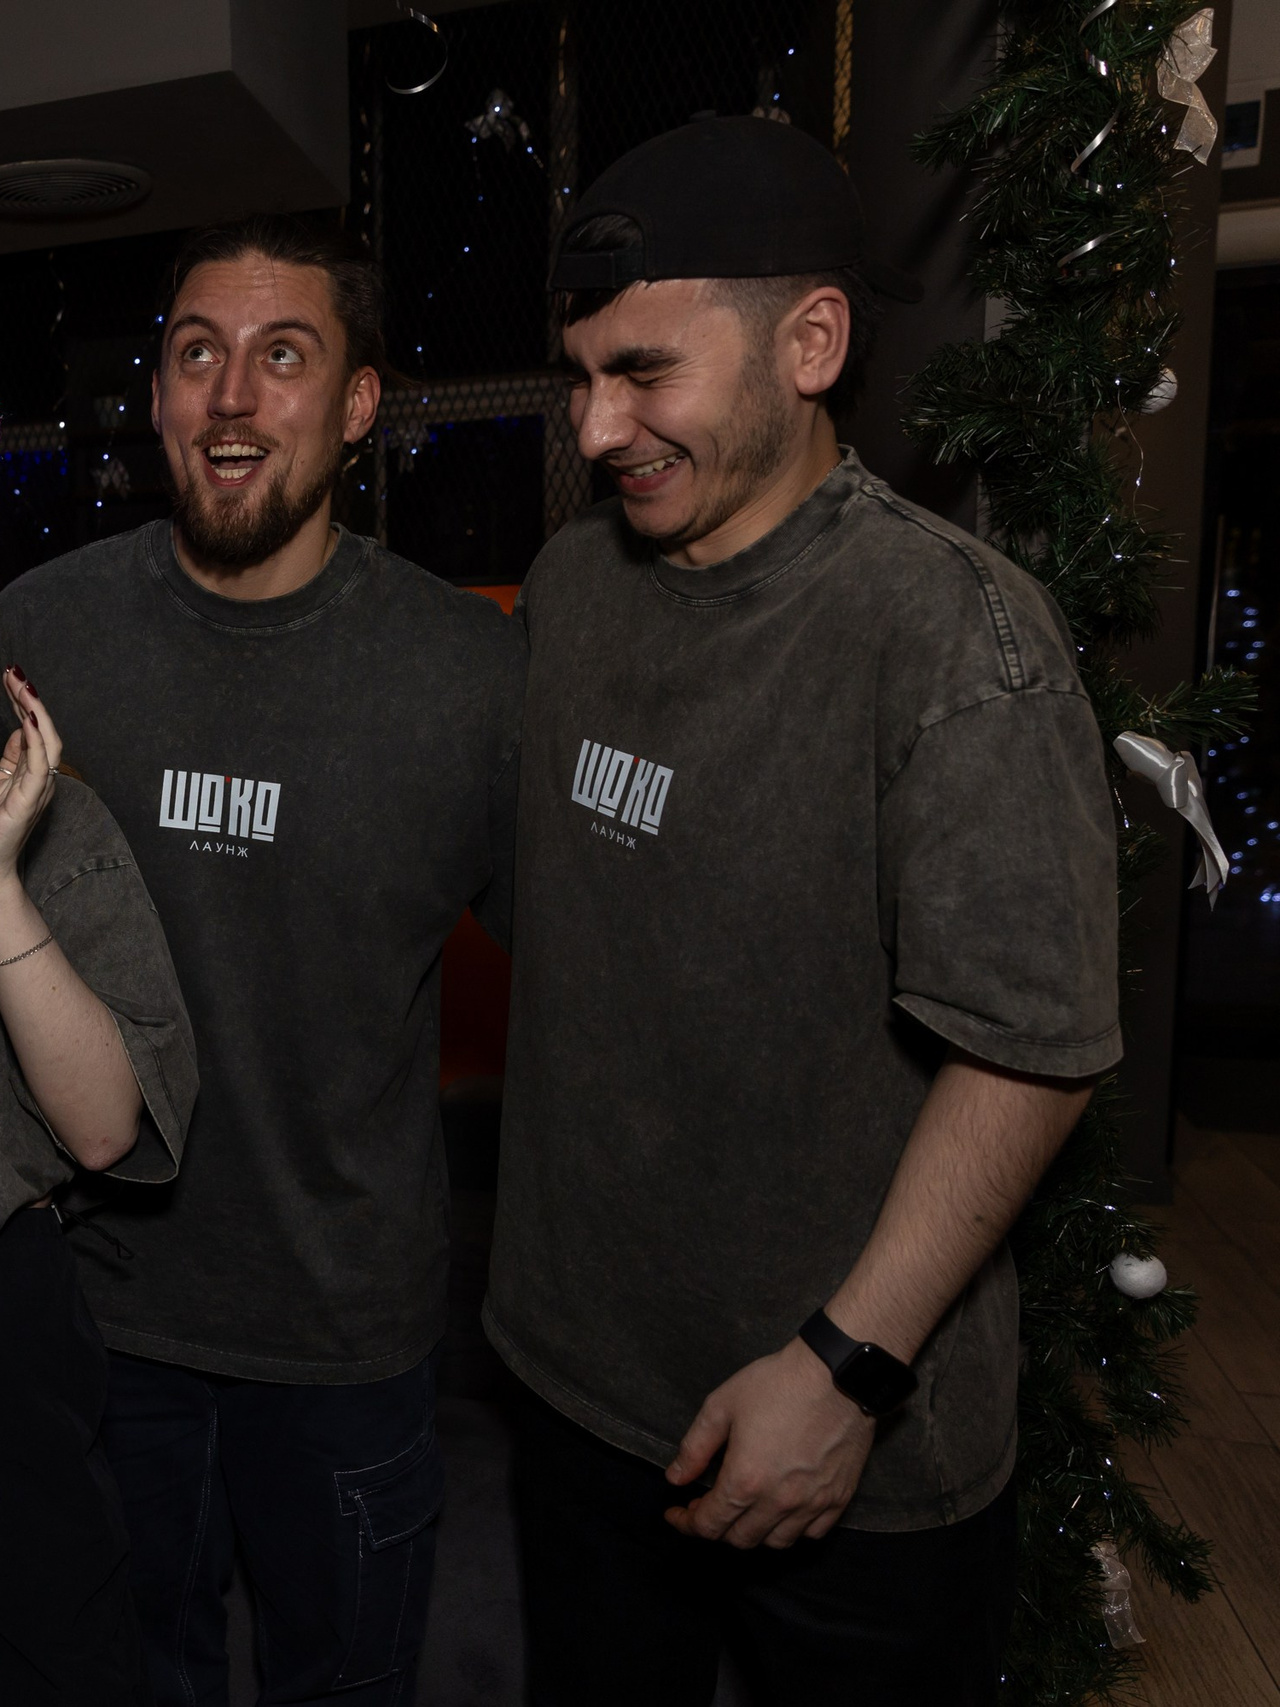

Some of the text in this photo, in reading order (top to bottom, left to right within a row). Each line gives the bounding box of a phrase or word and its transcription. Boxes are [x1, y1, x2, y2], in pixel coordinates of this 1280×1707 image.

[159, 769, 281, 842] ШОКО
[571, 738, 674, 836] ШОКО
[189, 840, 249, 858] ЛАУНЖ
[591, 821, 637, 850] ЛАУНЖ
